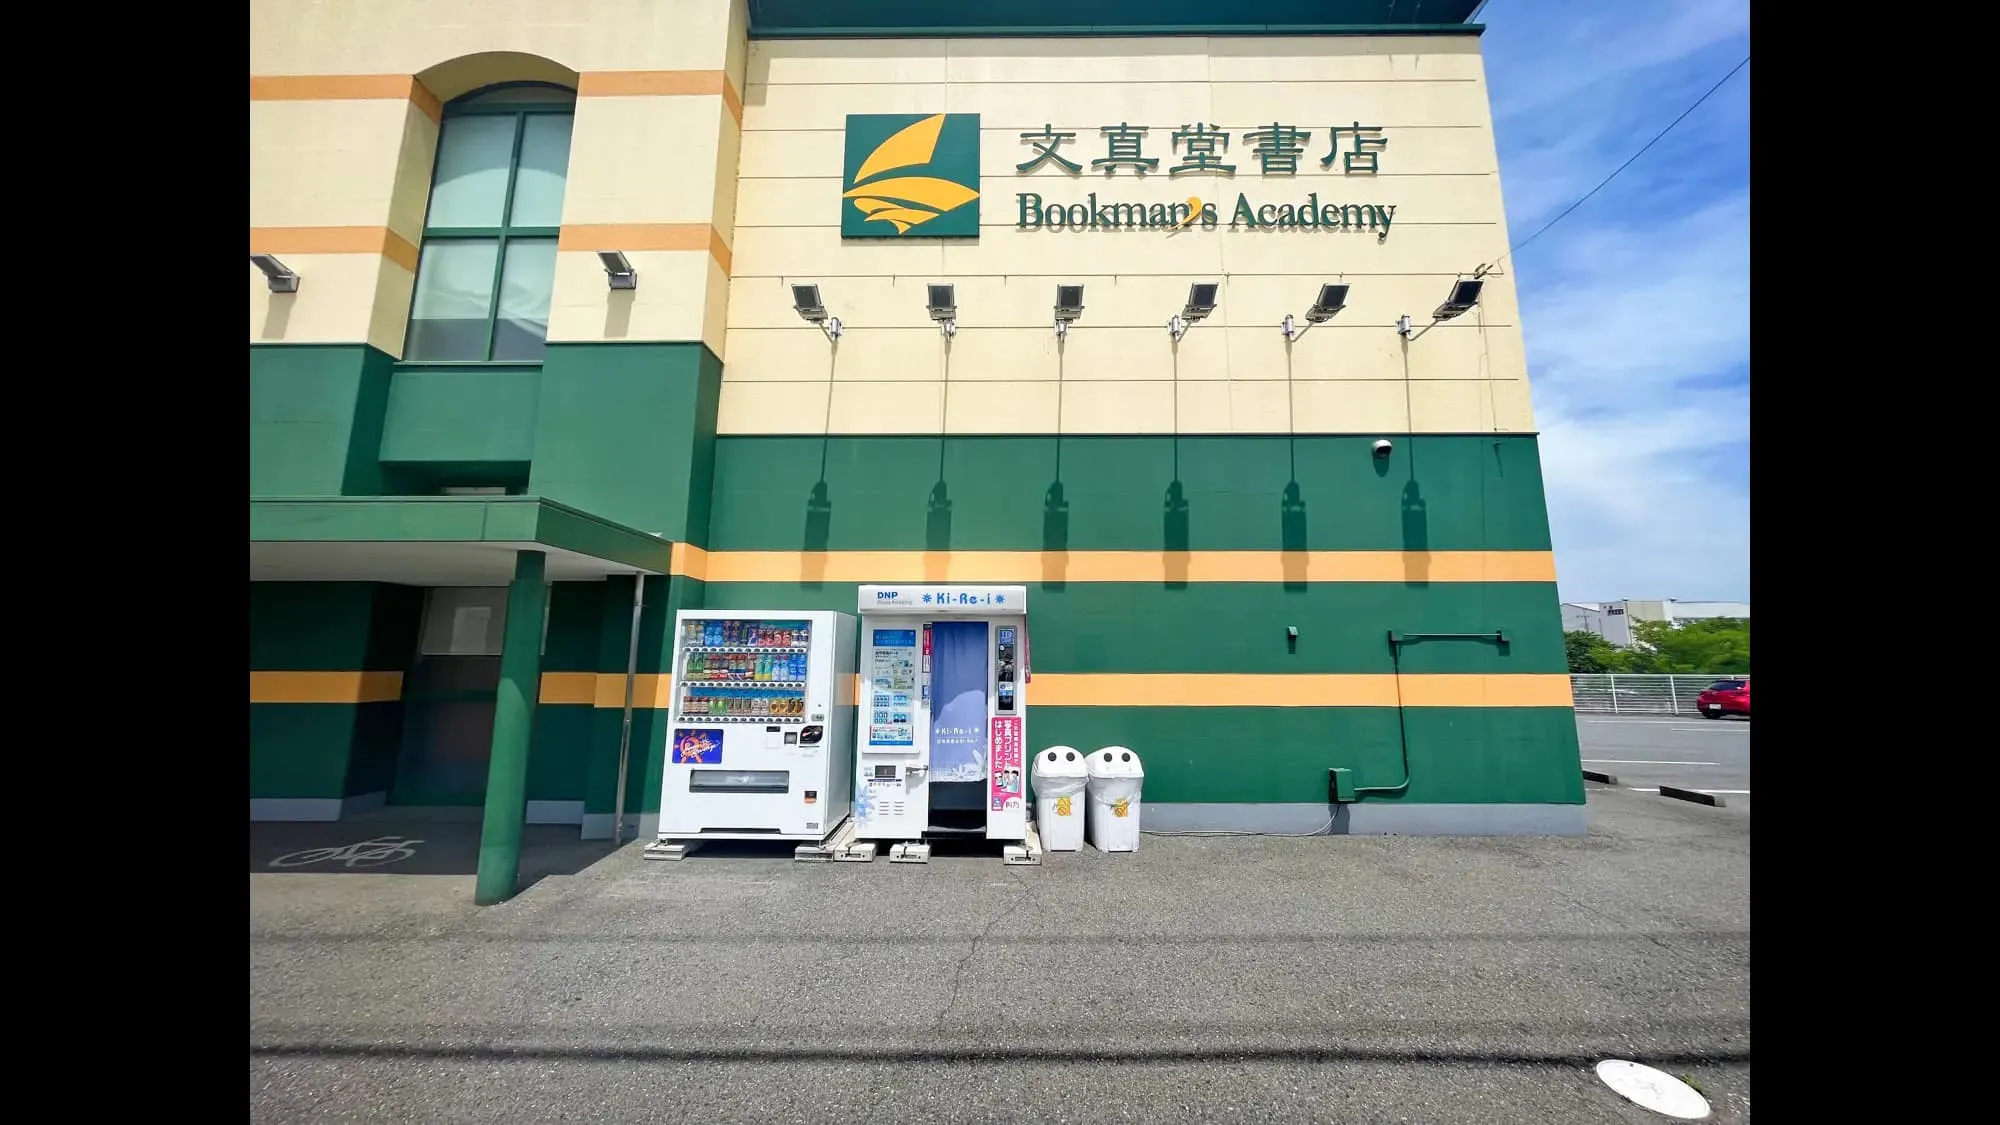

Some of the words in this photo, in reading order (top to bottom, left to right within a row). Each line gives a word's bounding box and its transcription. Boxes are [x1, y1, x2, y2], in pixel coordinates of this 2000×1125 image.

[1016, 121, 1389, 176] 文真堂書店
[1016, 191, 1218, 231] Bookman's
[1229, 191, 1397, 240] Academy
[877, 591, 898, 599] DNP
[936, 592, 991, 604] Ki-Re-i
[994, 719, 1003, 769] はじめました
